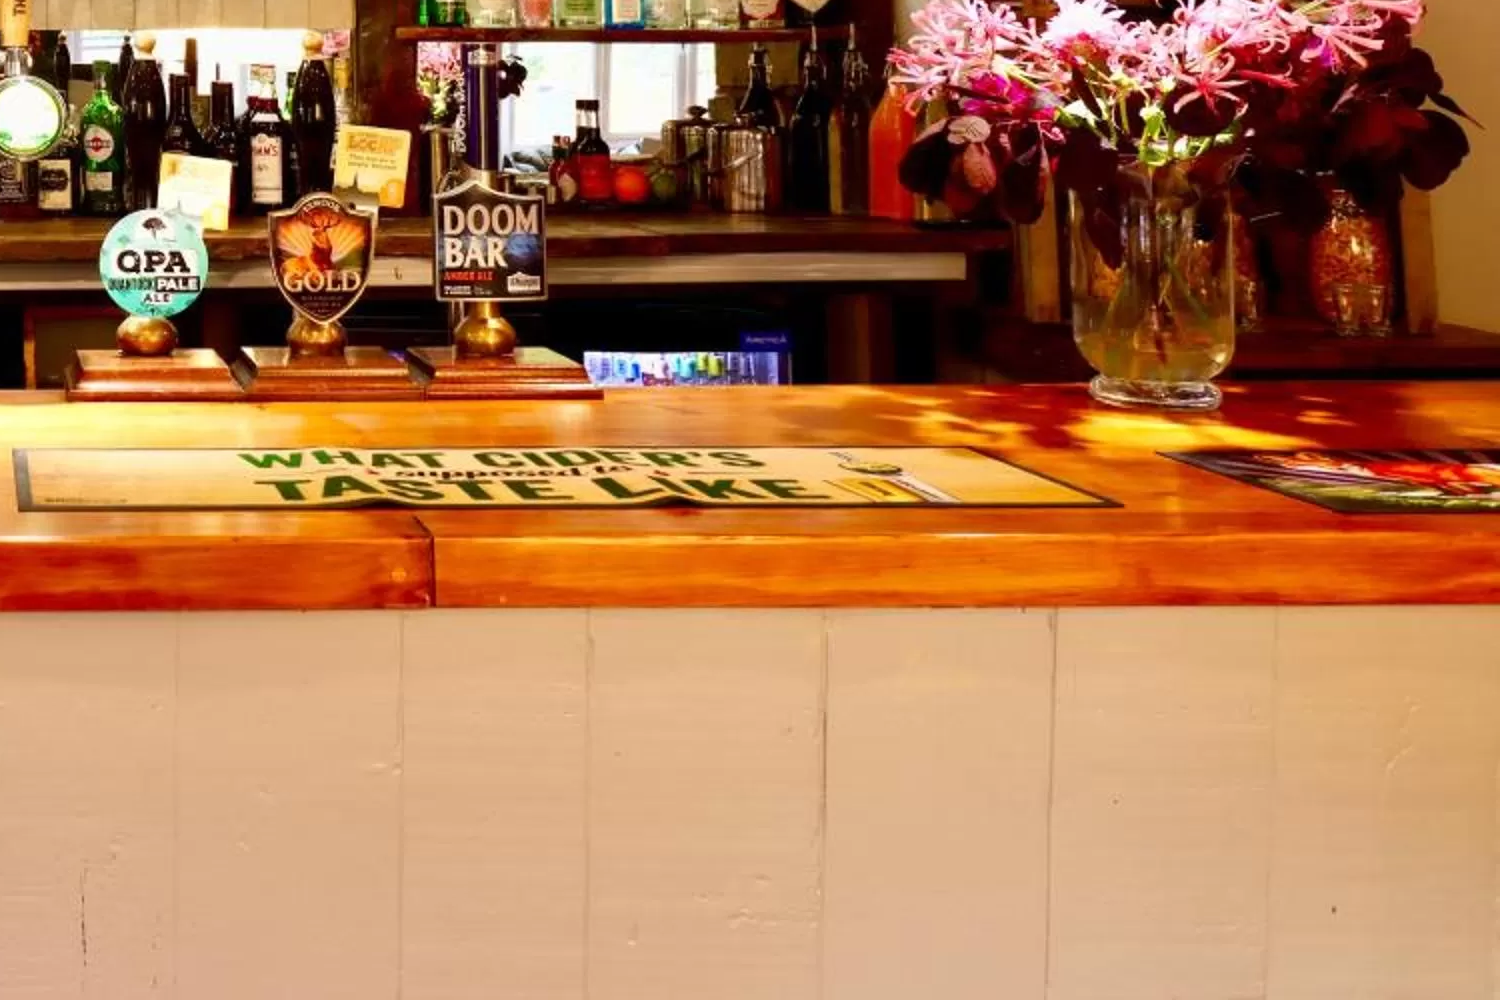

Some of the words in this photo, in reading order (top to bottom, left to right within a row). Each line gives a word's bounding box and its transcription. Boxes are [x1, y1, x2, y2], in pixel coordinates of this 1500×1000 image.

[443, 203, 539, 236] DOOM
[116, 250, 191, 273] QPA
[444, 236, 508, 269] BAR
[157, 277, 199, 290] PALE
[283, 271, 360, 292] GOLD
[143, 293, 172, 303] ALE
[238, 450, 444, 469] WHAT
[473, 450, 766, 468] CIDER'S
[253, 475, 575, 501] TASTE
[591, 475, 831, 500] LIKE
